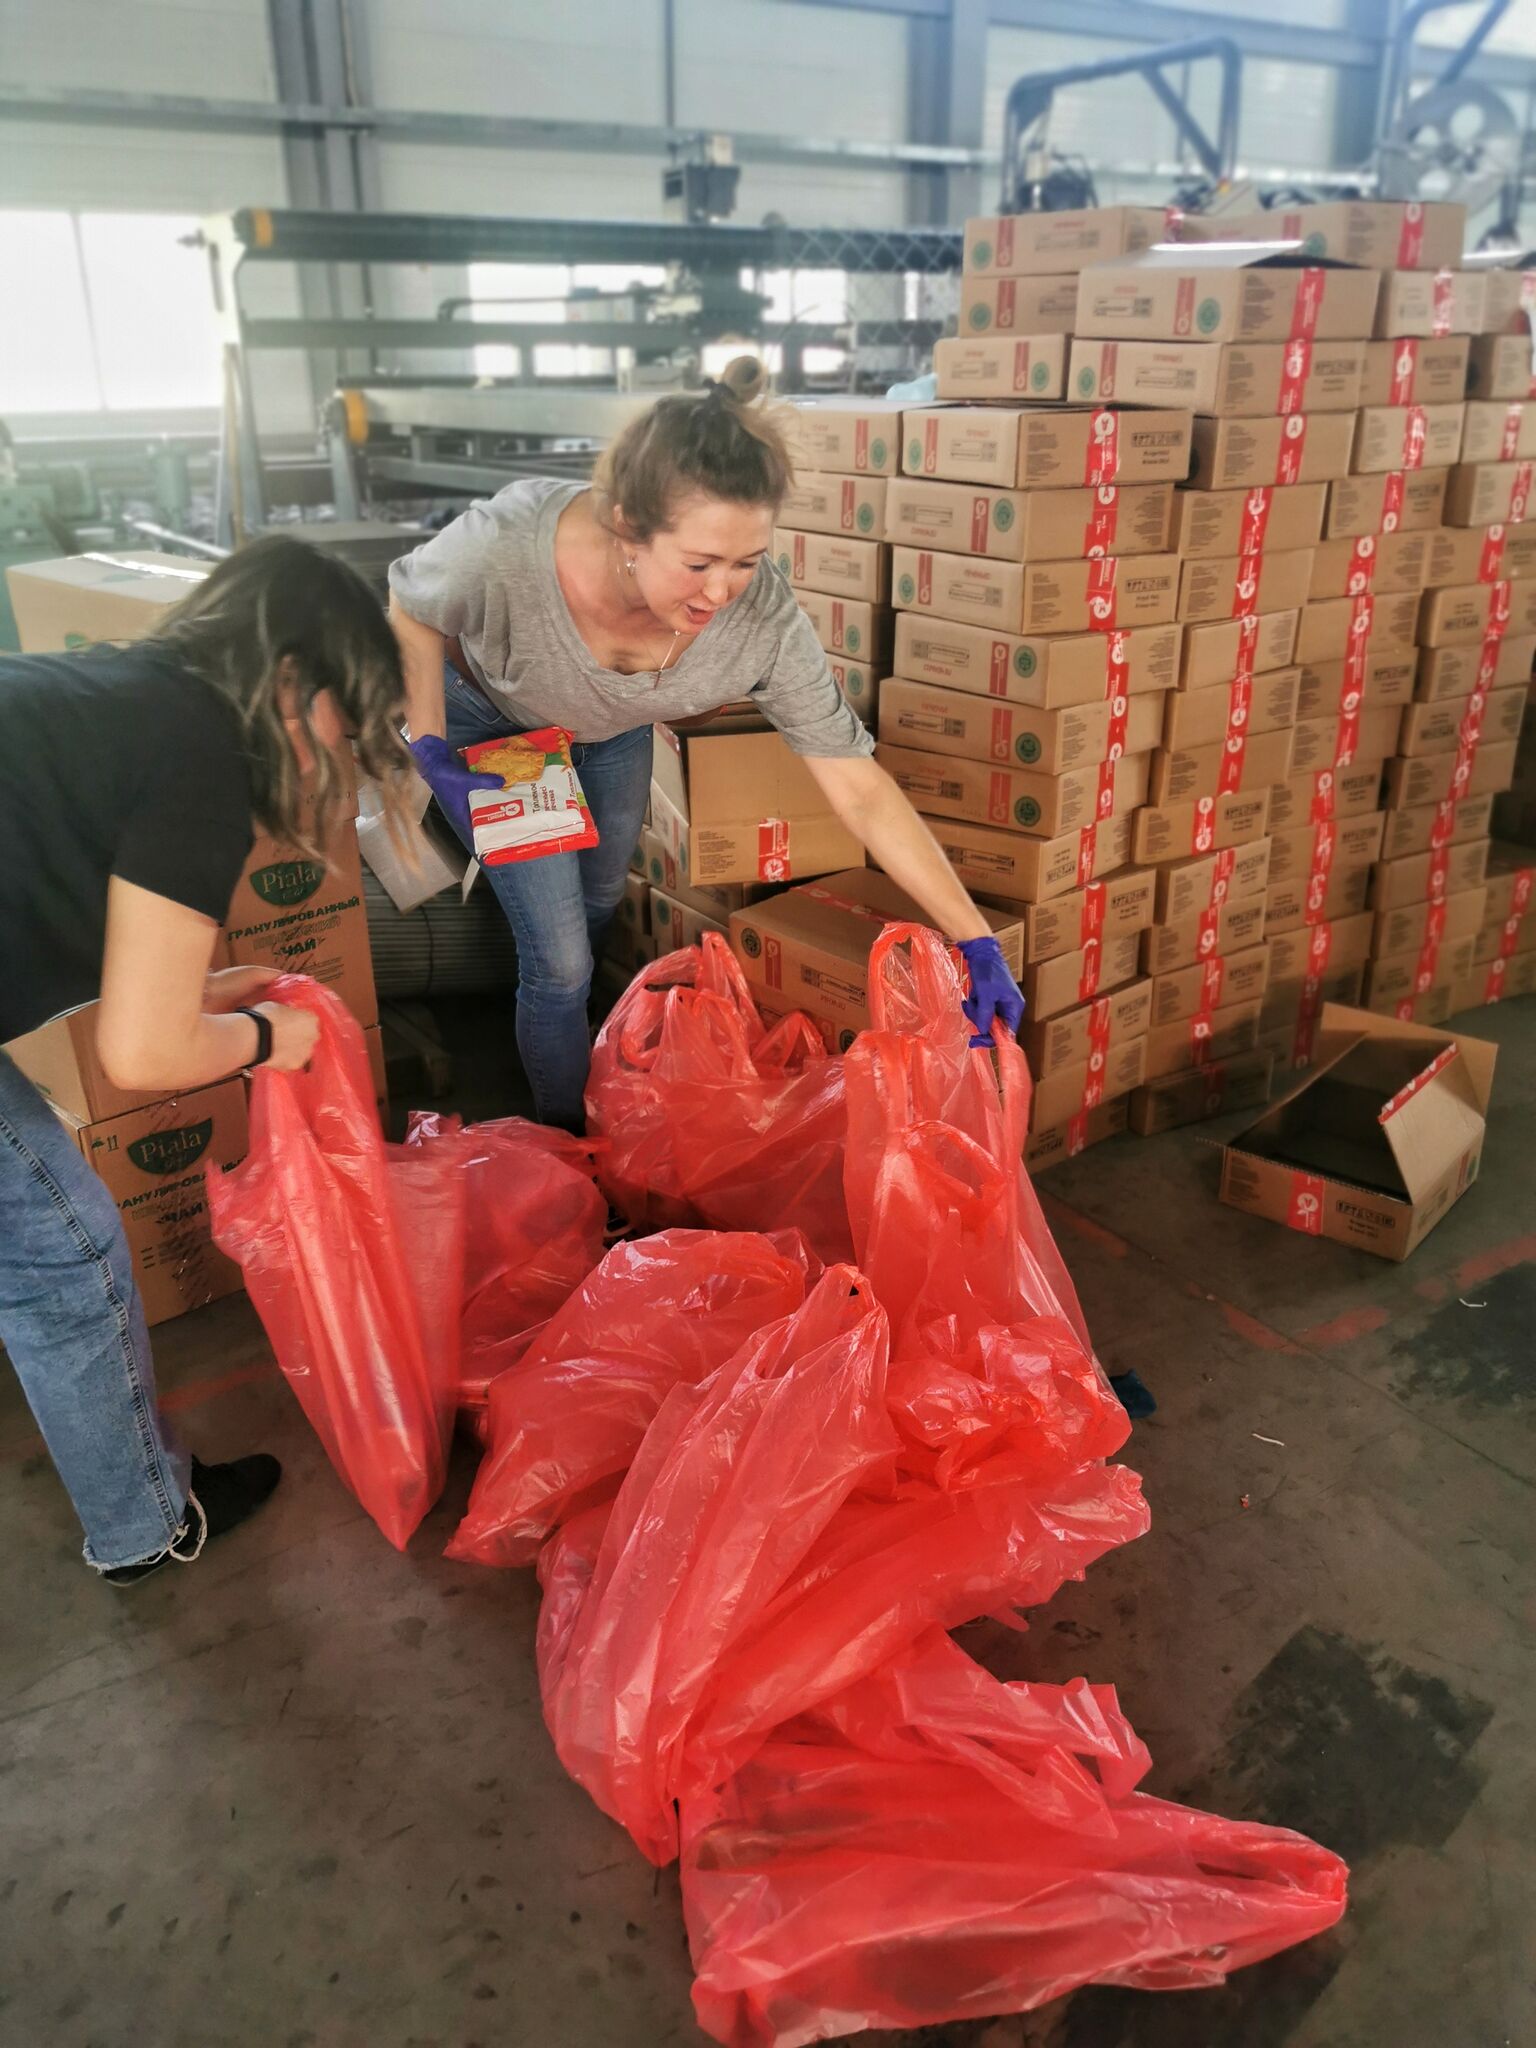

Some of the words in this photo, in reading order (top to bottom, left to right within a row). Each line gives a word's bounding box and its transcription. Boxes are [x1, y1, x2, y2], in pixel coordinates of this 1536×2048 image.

[261, 864, 317, 894] Piala
[228, 895, 361, 942] ГРАНУЛИРОВАННЫЙ
[279, 937, 317, 957] ЧАЙ
[140, 1129, 202, 1165] Piala
